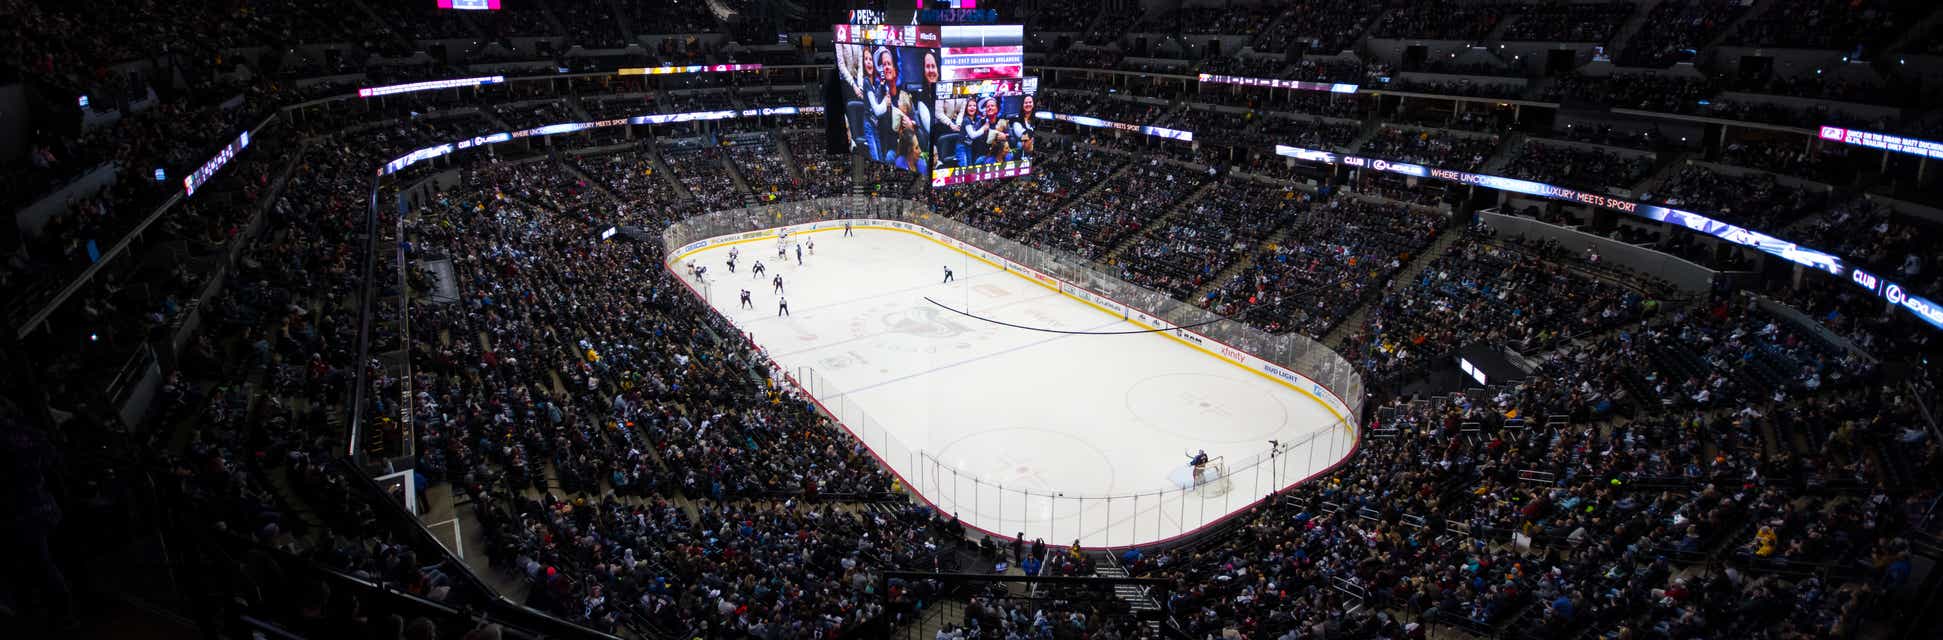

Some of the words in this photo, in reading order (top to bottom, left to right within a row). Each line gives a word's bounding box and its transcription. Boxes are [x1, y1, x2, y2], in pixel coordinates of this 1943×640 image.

[1344, 156, 1365, 166] CLUB
[1431, 169, 1459, 181] WHERE
[1541, 184, 1575, 200] LUXURY
[1577, 192, 1605, 206] MEETS
[1606, 198, 1637, 212] SPORT
[1853, 269, 1877, 290] CLUB
[1264, 364, 1278, 375] BUD
[1278, 370, 1298, 383] LIGHT
